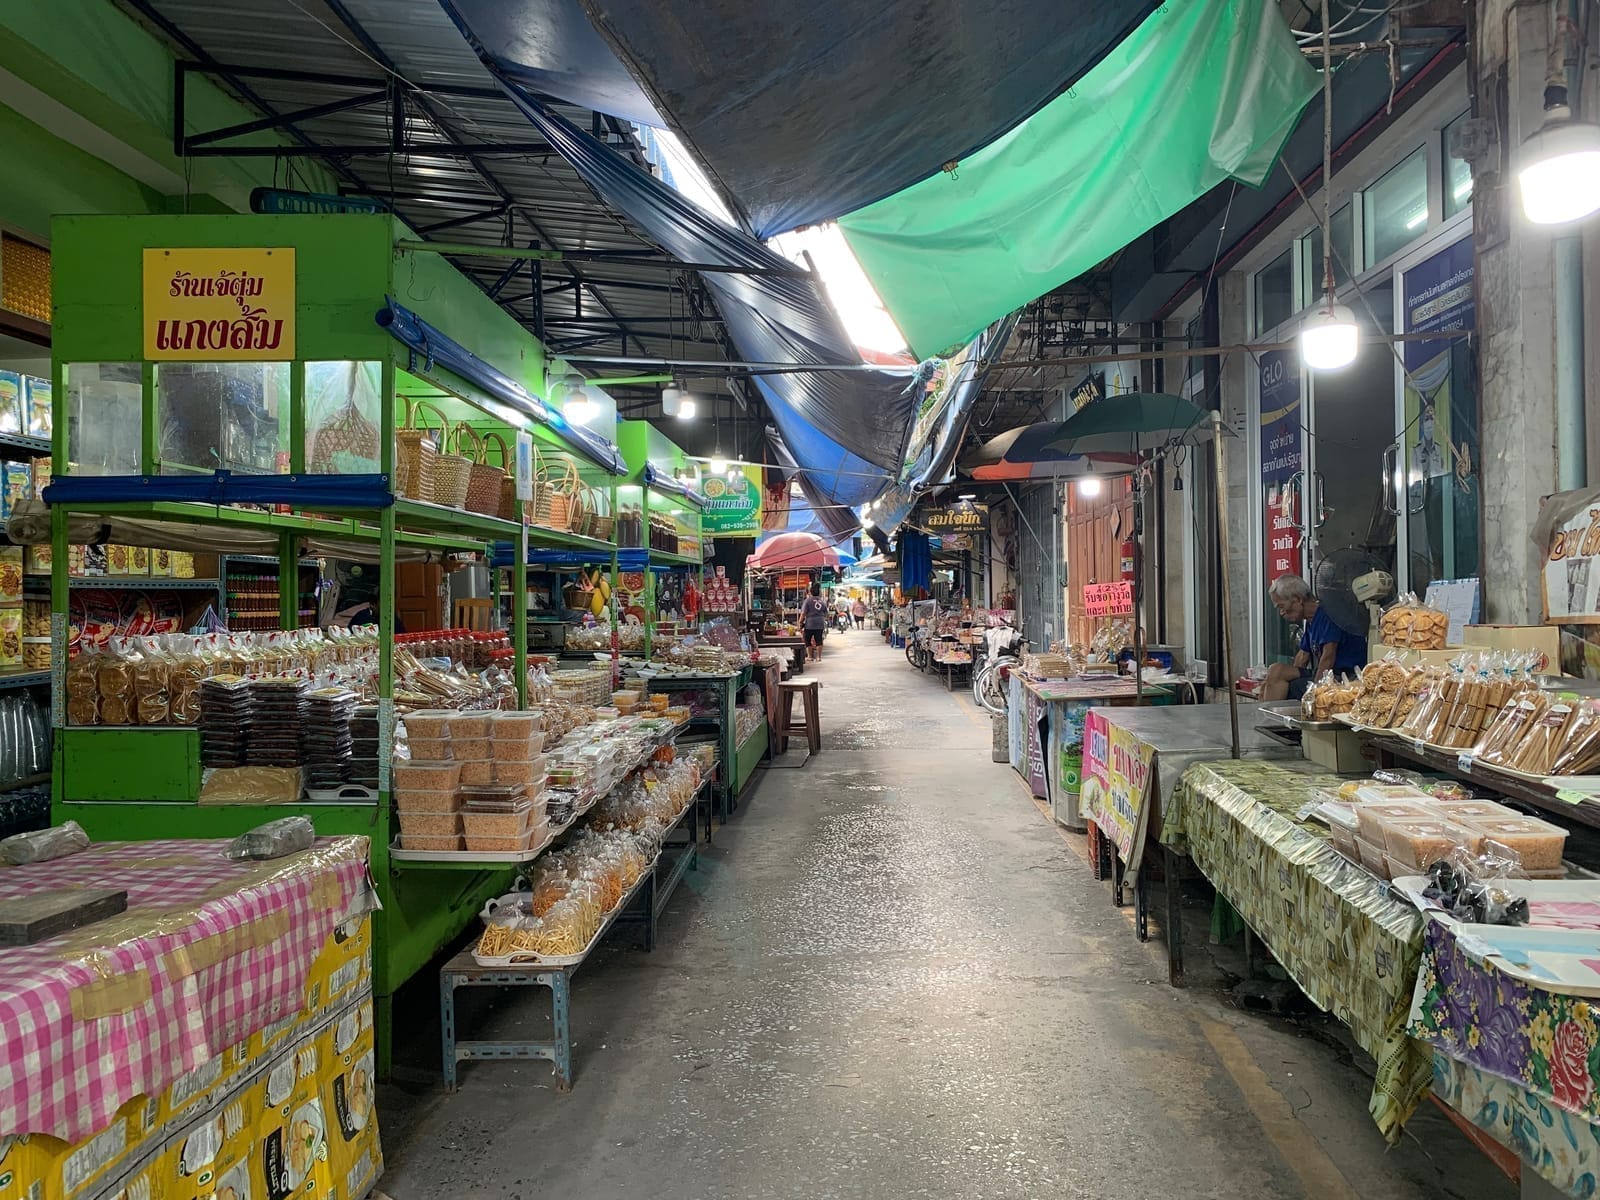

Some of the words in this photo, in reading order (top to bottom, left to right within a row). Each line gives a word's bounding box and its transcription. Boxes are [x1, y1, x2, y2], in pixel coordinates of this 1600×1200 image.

[169, 270, 264, 307] ร้านเจ้ตุ่ม
[156, 304, 284, 350] แกงส้ม
[1262, 360, 1282, 387] GLO
[928, 509, 981, 526] สมใจนึก
